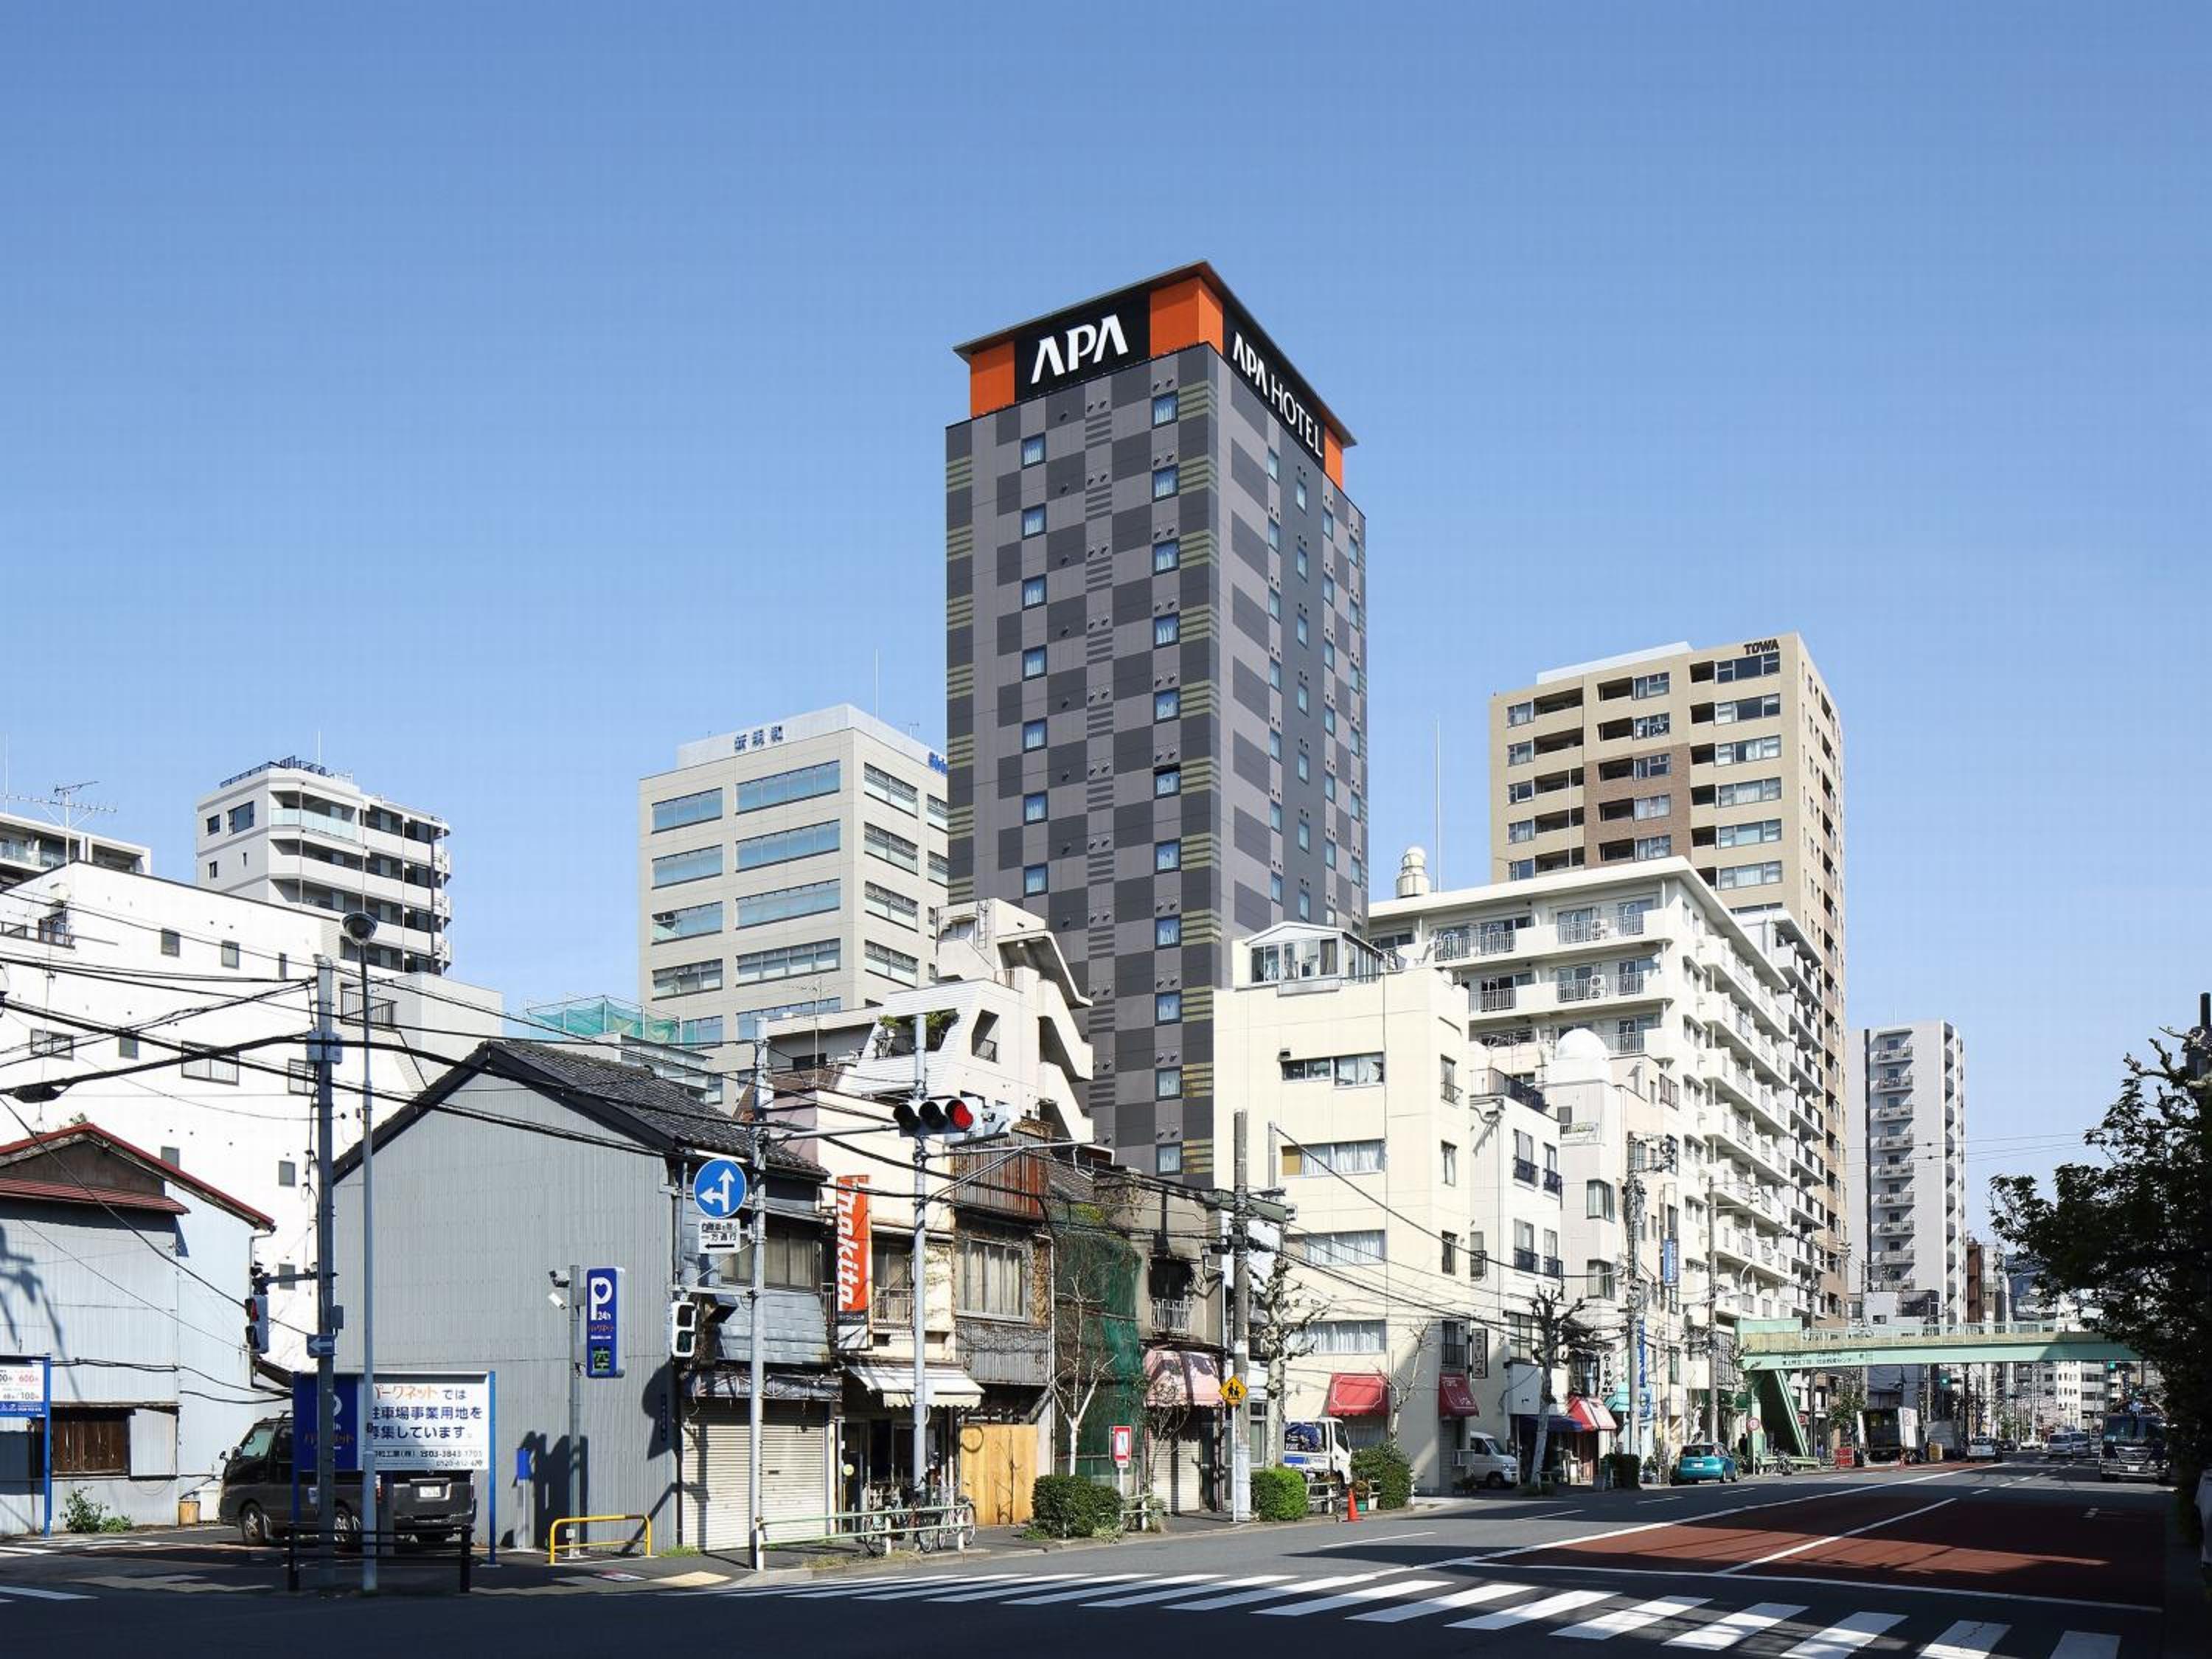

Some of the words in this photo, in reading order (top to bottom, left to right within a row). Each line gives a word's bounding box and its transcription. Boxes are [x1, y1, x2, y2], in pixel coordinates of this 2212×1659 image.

[1031, 313, 1129, 384] APA
[1233, 331, 1268, 397] APA
[1270, 374, 1324, 459] HOTEL
[1744, 639, 1779, 655] TOWA
